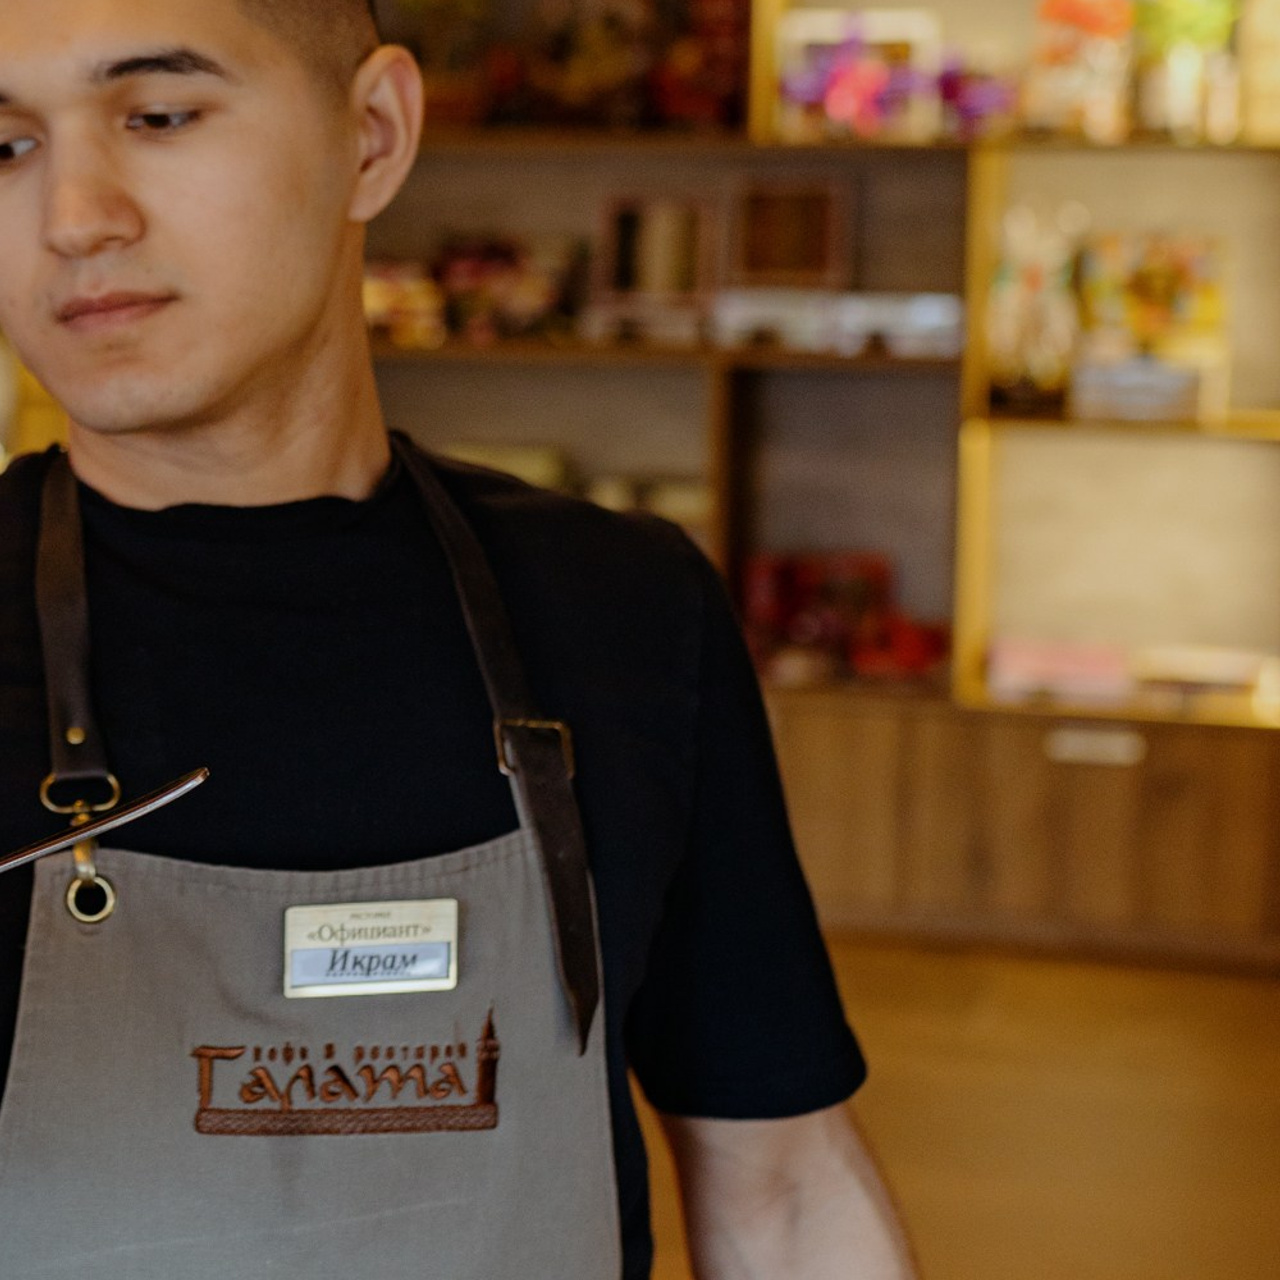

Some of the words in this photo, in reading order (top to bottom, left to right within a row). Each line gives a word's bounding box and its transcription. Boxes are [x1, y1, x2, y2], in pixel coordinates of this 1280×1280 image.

[307, 922, 433, 947] «Официант»
[328, 947, 419, 977] Икрам
[191, 1045, 469, 1110] Галата
